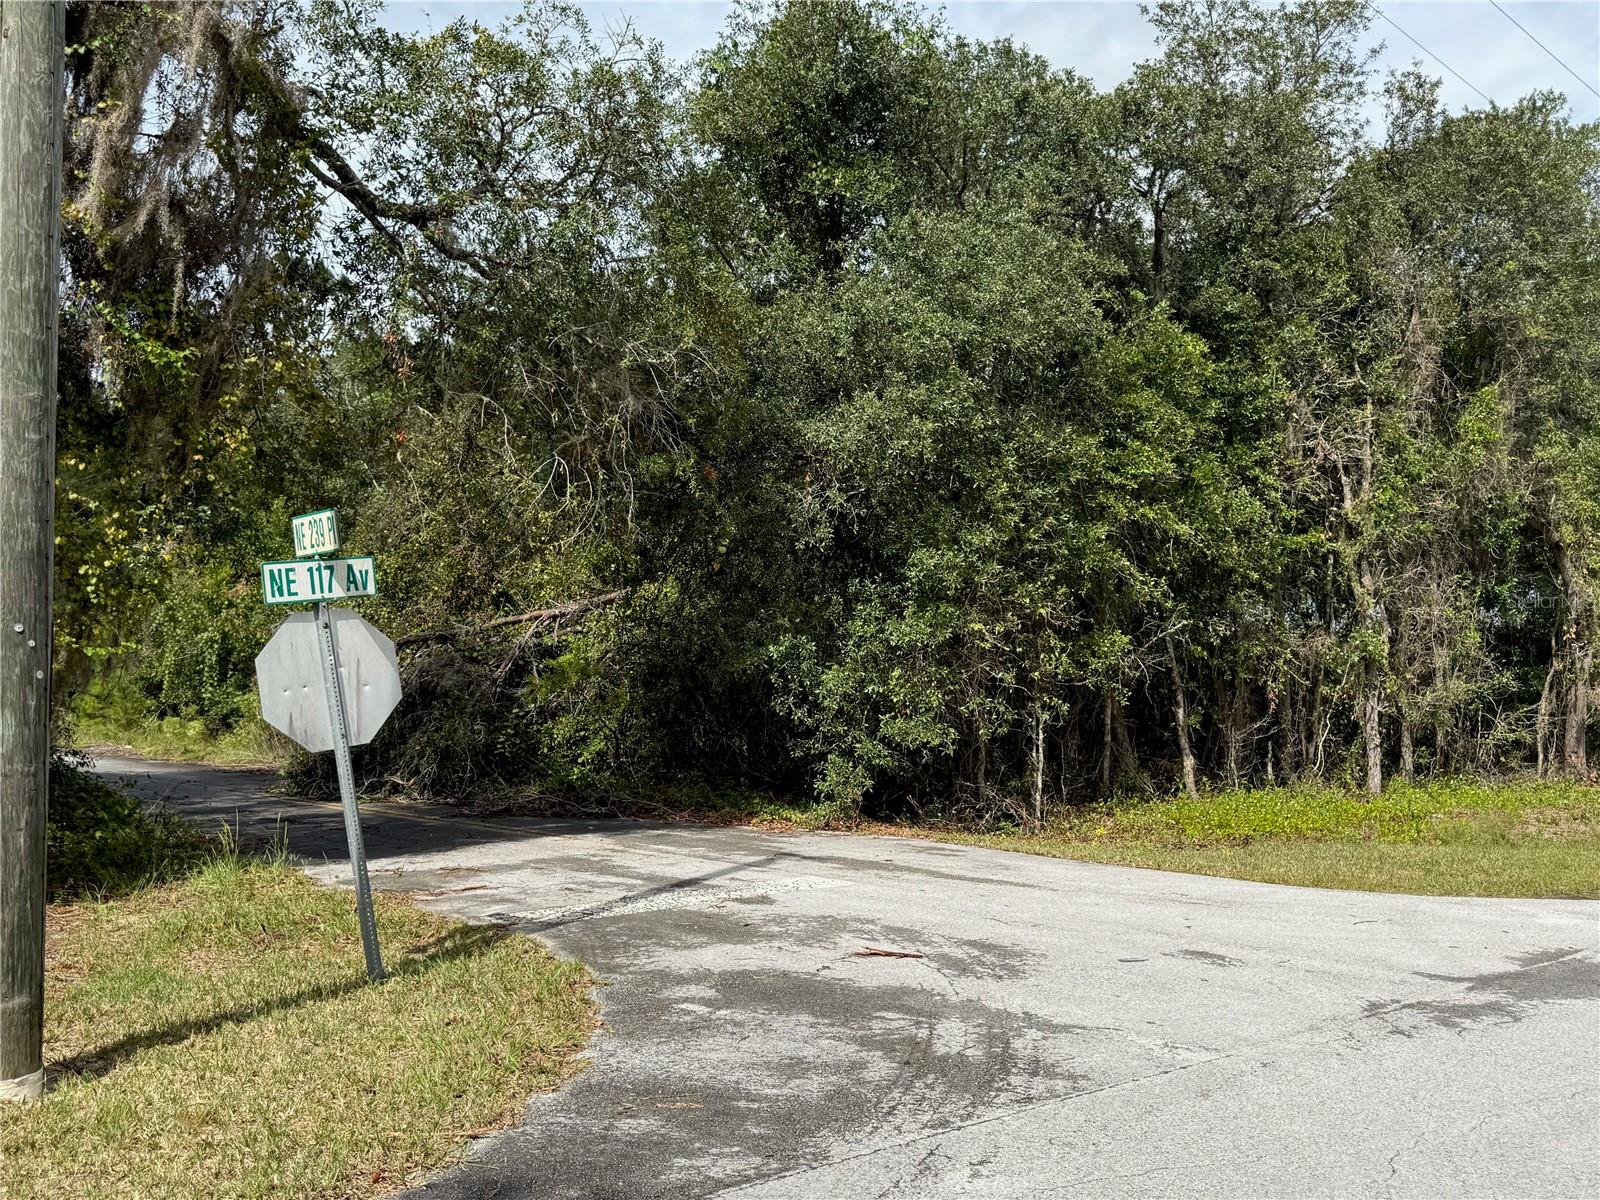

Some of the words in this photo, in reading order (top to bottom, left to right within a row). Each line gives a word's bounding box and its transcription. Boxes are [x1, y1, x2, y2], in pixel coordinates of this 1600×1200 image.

[295, 522, 307, 551] NE
[308, 517, 326, 549] 239
[268, 567, 299, 598] NE
[307, 564, 335, 595] 117
[346, 563, 369, 592] Av
